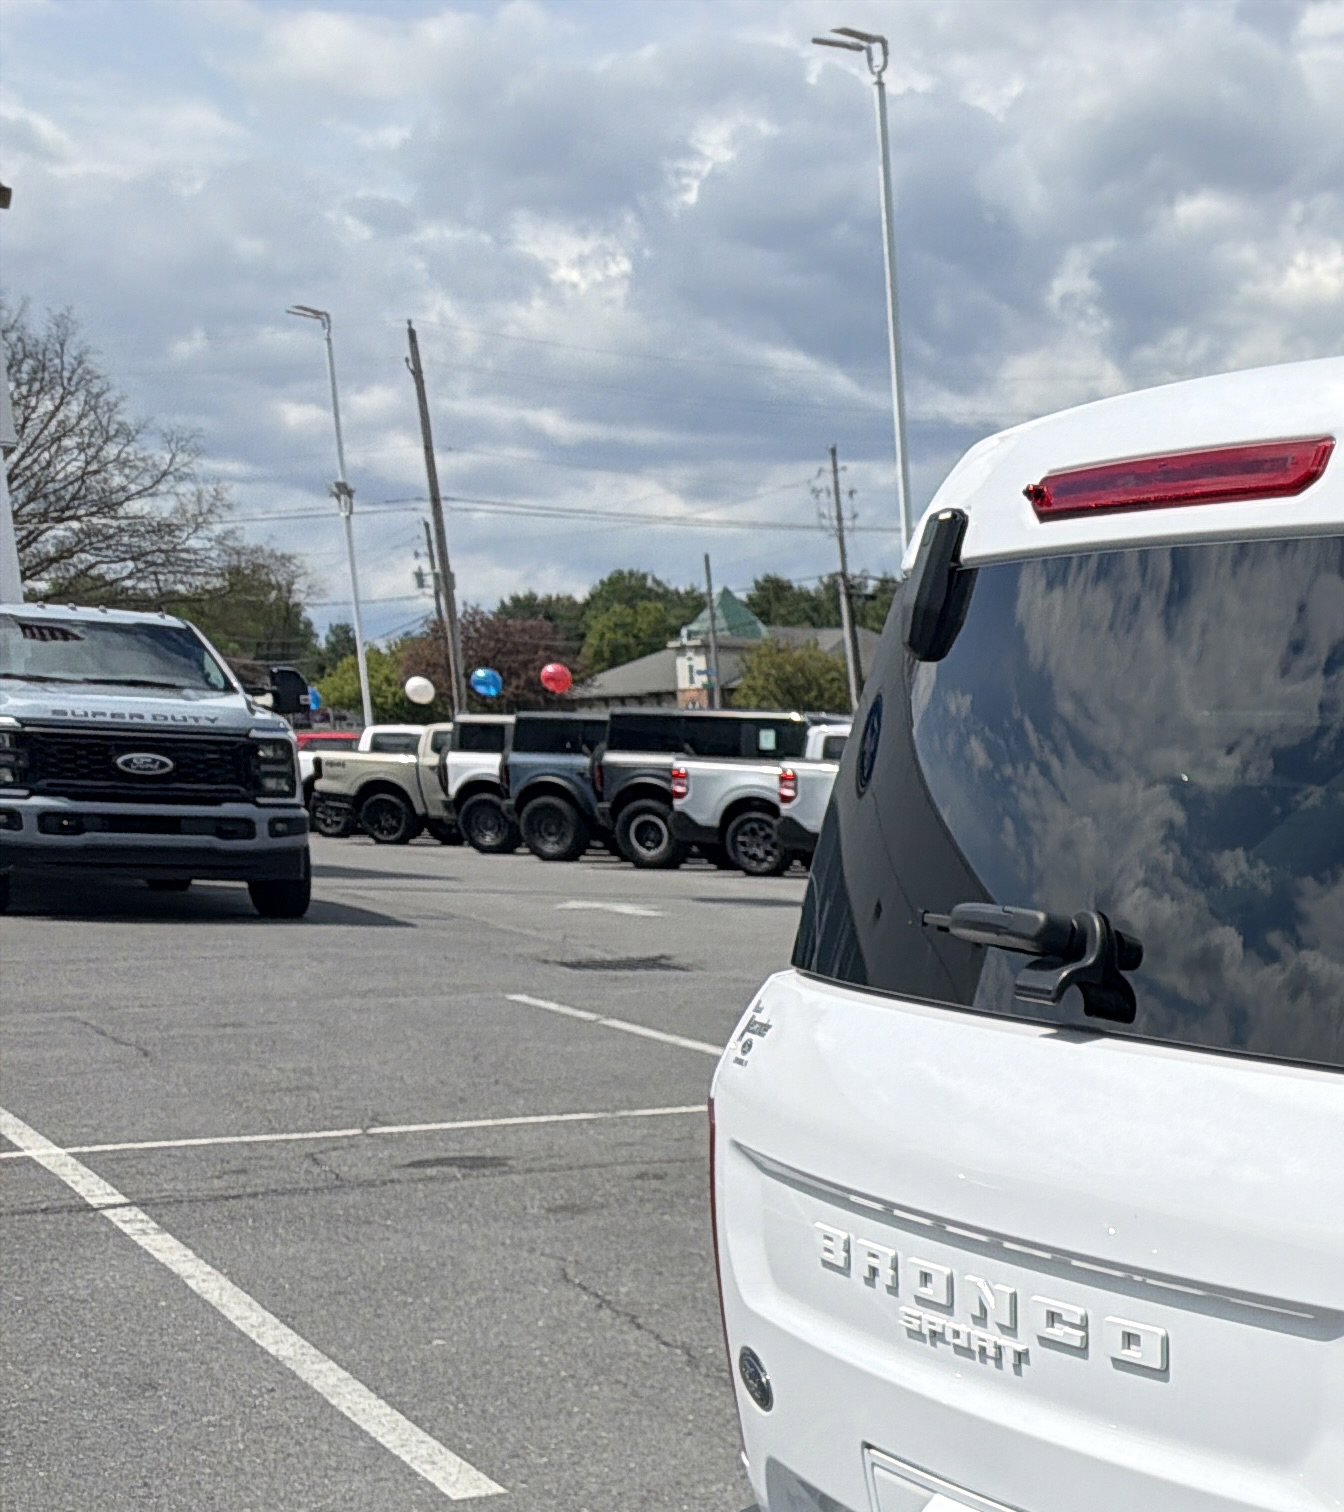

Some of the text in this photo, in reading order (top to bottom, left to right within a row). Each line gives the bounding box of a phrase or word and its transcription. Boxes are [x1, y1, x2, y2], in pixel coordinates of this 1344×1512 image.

[51, 708, 219, 724] SUPER DUTY
[814, 1221, 1169, 1374] BRONCO
[899, 1305, 1029, 1374] SPORT
